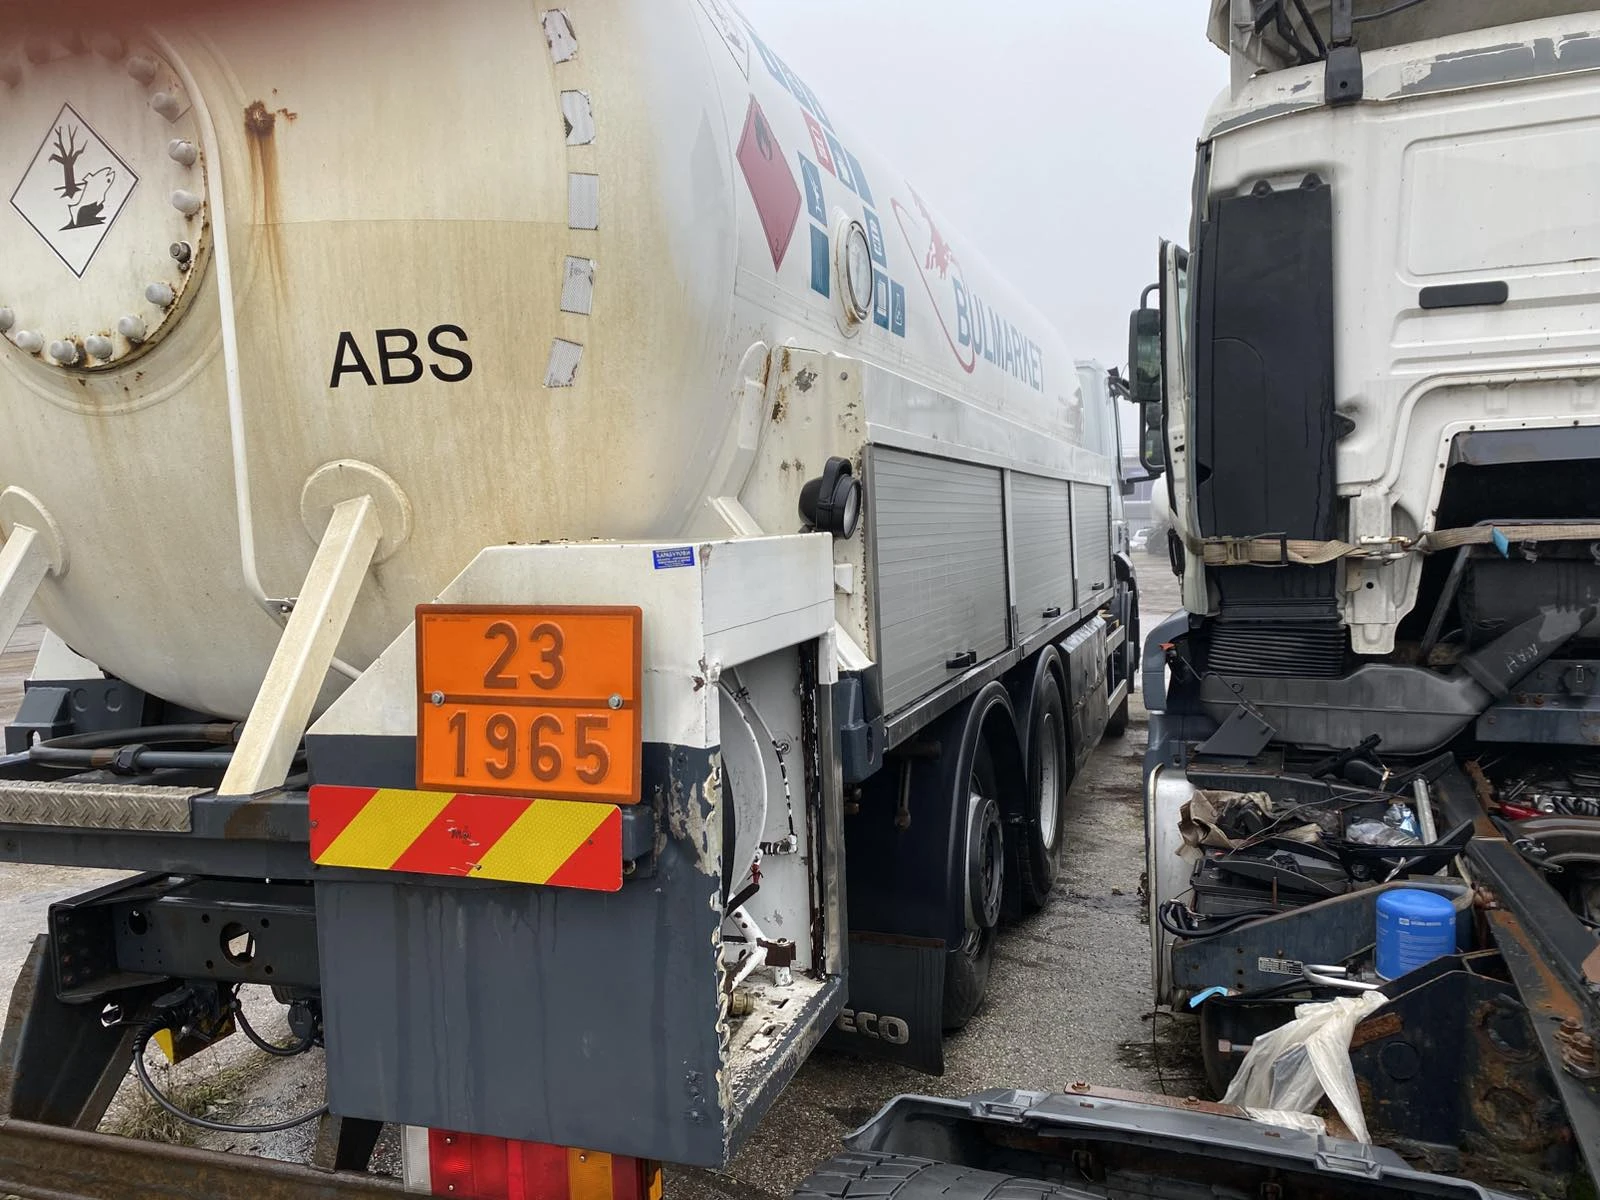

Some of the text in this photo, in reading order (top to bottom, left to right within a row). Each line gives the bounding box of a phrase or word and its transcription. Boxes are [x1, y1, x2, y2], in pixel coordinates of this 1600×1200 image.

[329, 323, 473, 388] ABS
[951, 275, 1044, 393] BULMARKET
[483, 619, 566, 690] 23
[448, 709, 610, 785] 1965
